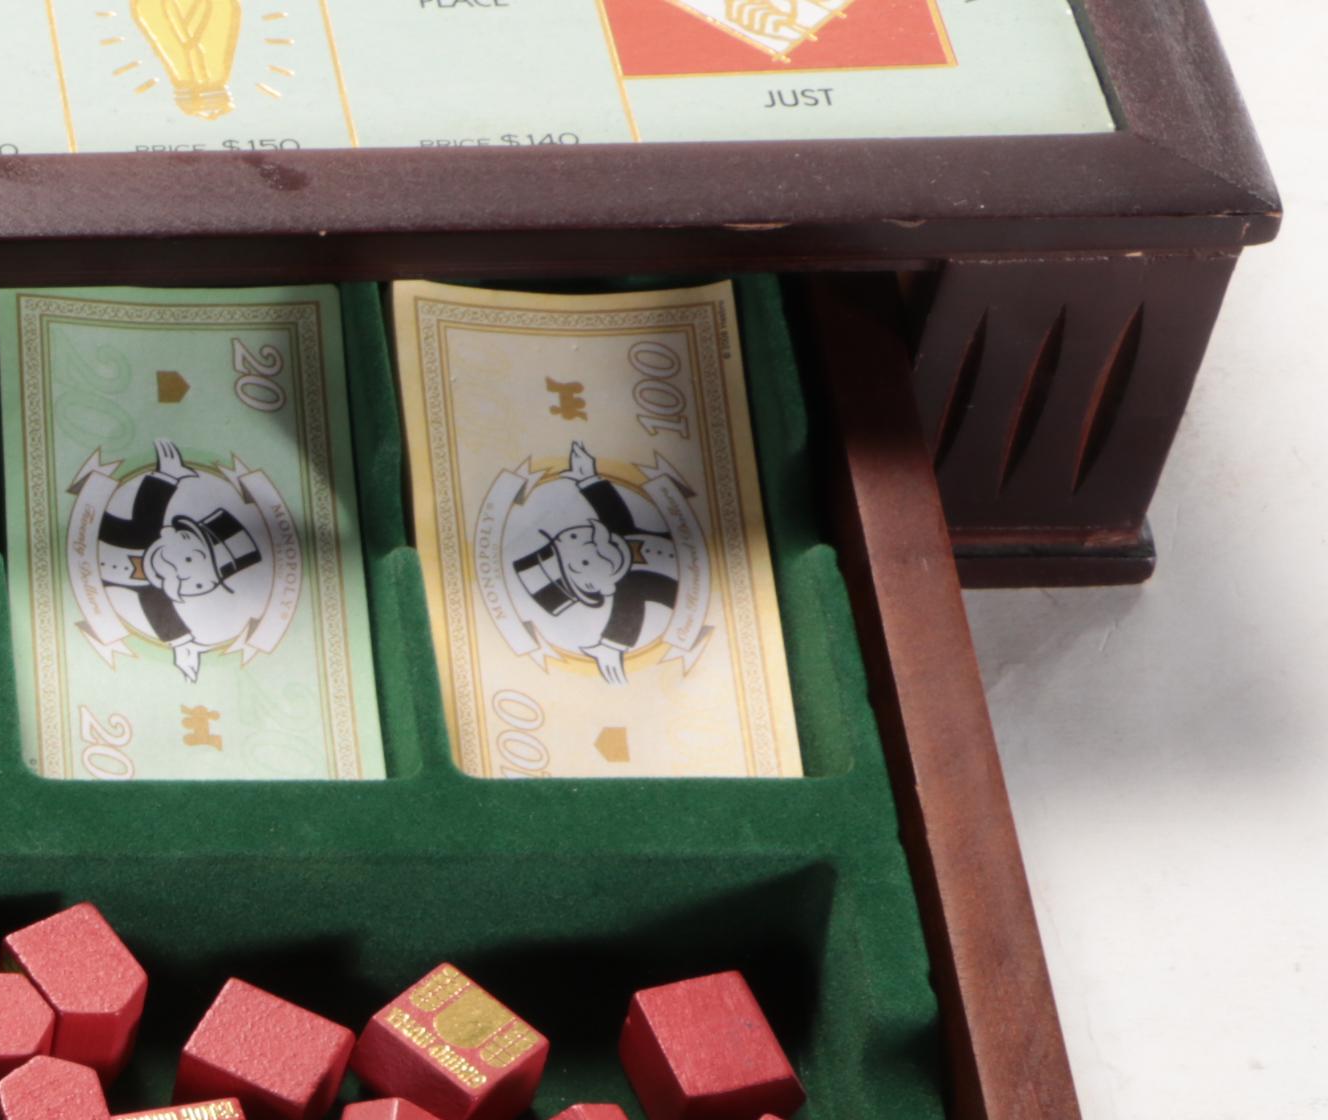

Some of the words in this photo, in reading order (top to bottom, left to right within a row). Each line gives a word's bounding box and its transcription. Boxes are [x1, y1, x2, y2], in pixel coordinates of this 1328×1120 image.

[763, 87, 835, 110] JUST
[230, 337, 286, 413] 20
[628, 340, 691, 440] 100
[78, 704, 135, 780] 20
